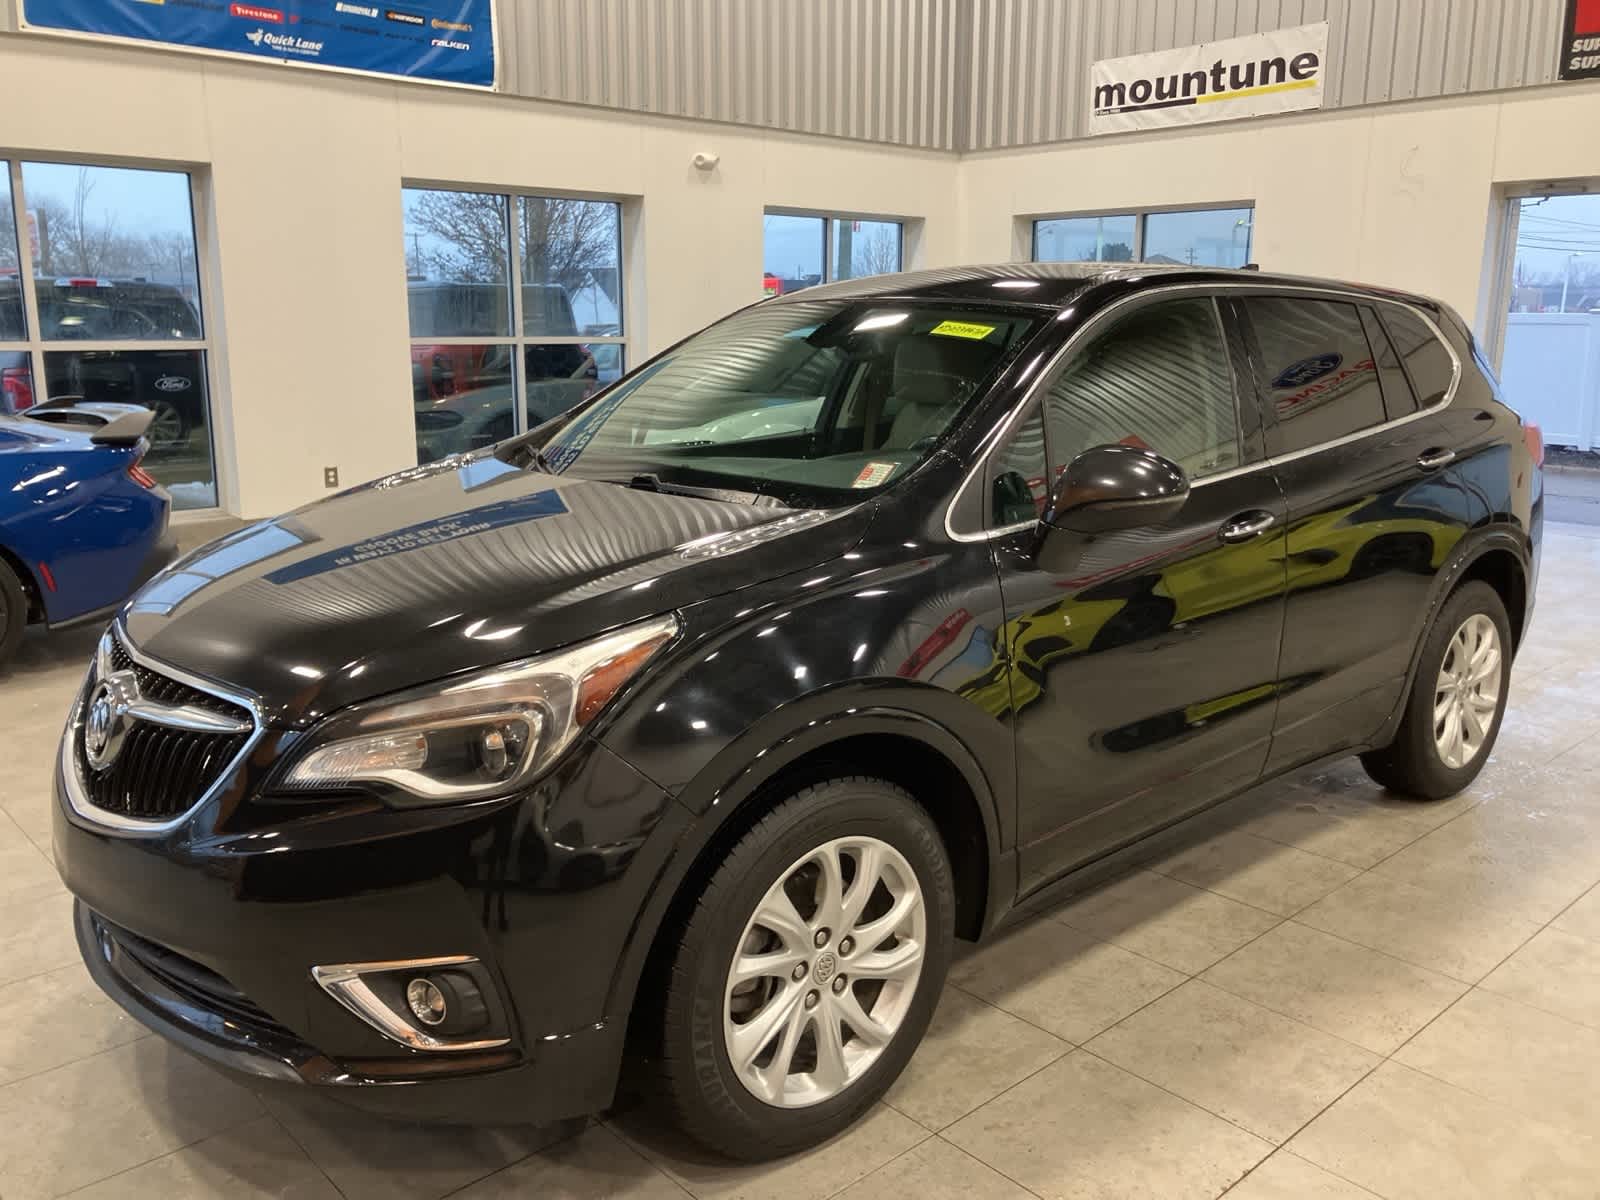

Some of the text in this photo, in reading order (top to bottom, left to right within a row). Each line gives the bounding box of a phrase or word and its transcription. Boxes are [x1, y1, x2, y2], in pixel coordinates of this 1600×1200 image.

[236, 6, 279, 20] Firestone
[264, 32, 323, 50] Quick Lane
[431, 39, 470, 50] FALKEN
[1094, 52, 1320, 109] mountune
